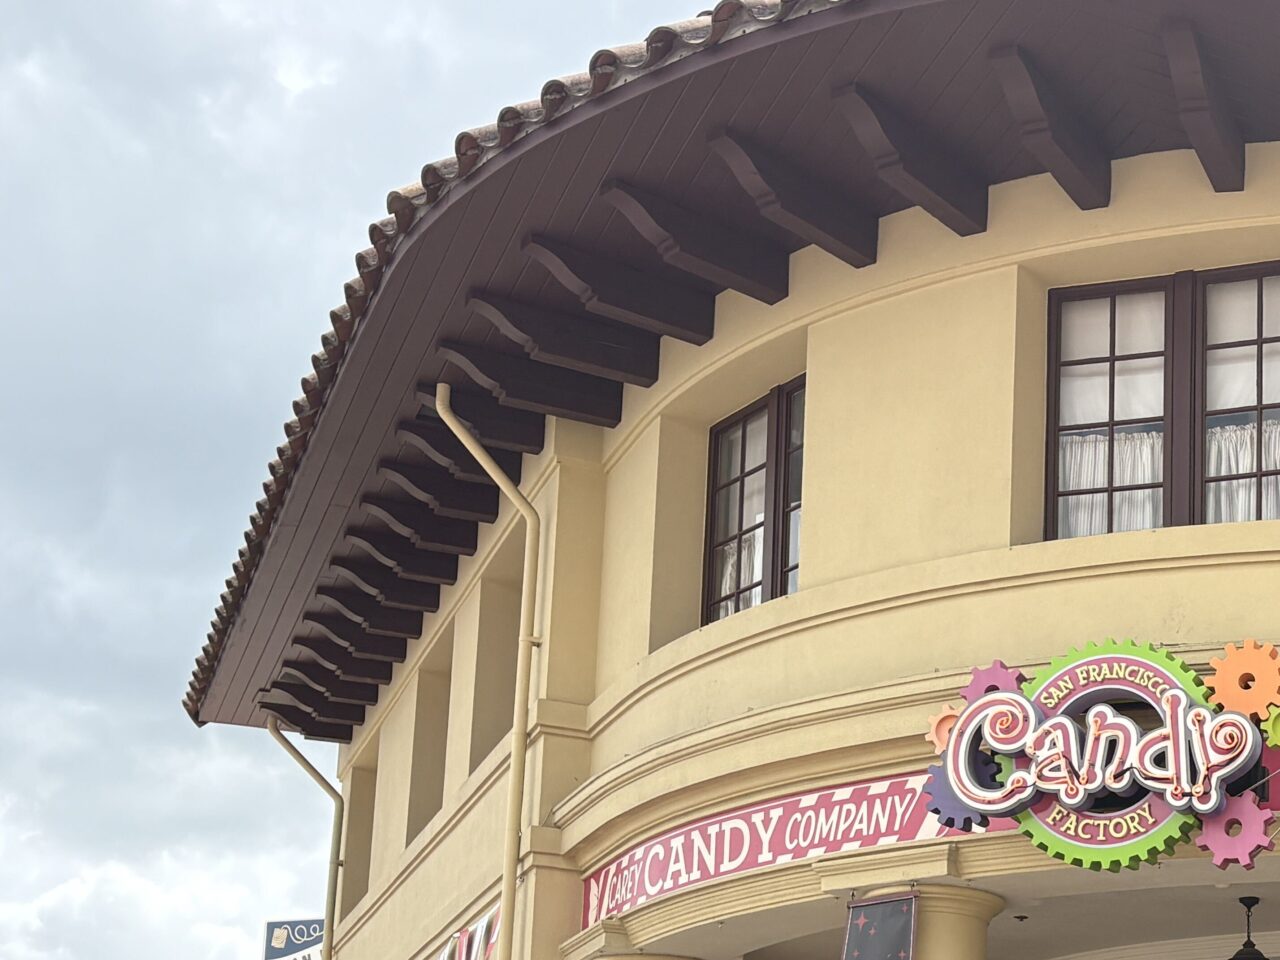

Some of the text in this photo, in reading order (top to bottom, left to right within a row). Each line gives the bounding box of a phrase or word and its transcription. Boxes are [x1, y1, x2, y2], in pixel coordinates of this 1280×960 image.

[1040, 676, 1075, 708] SAN
[947, 688, 1258, 815] Candy
[608, 796, 906, 909] CAREY CANDY COMPANY
[1045, 802, 1156, 841] FACTORY
